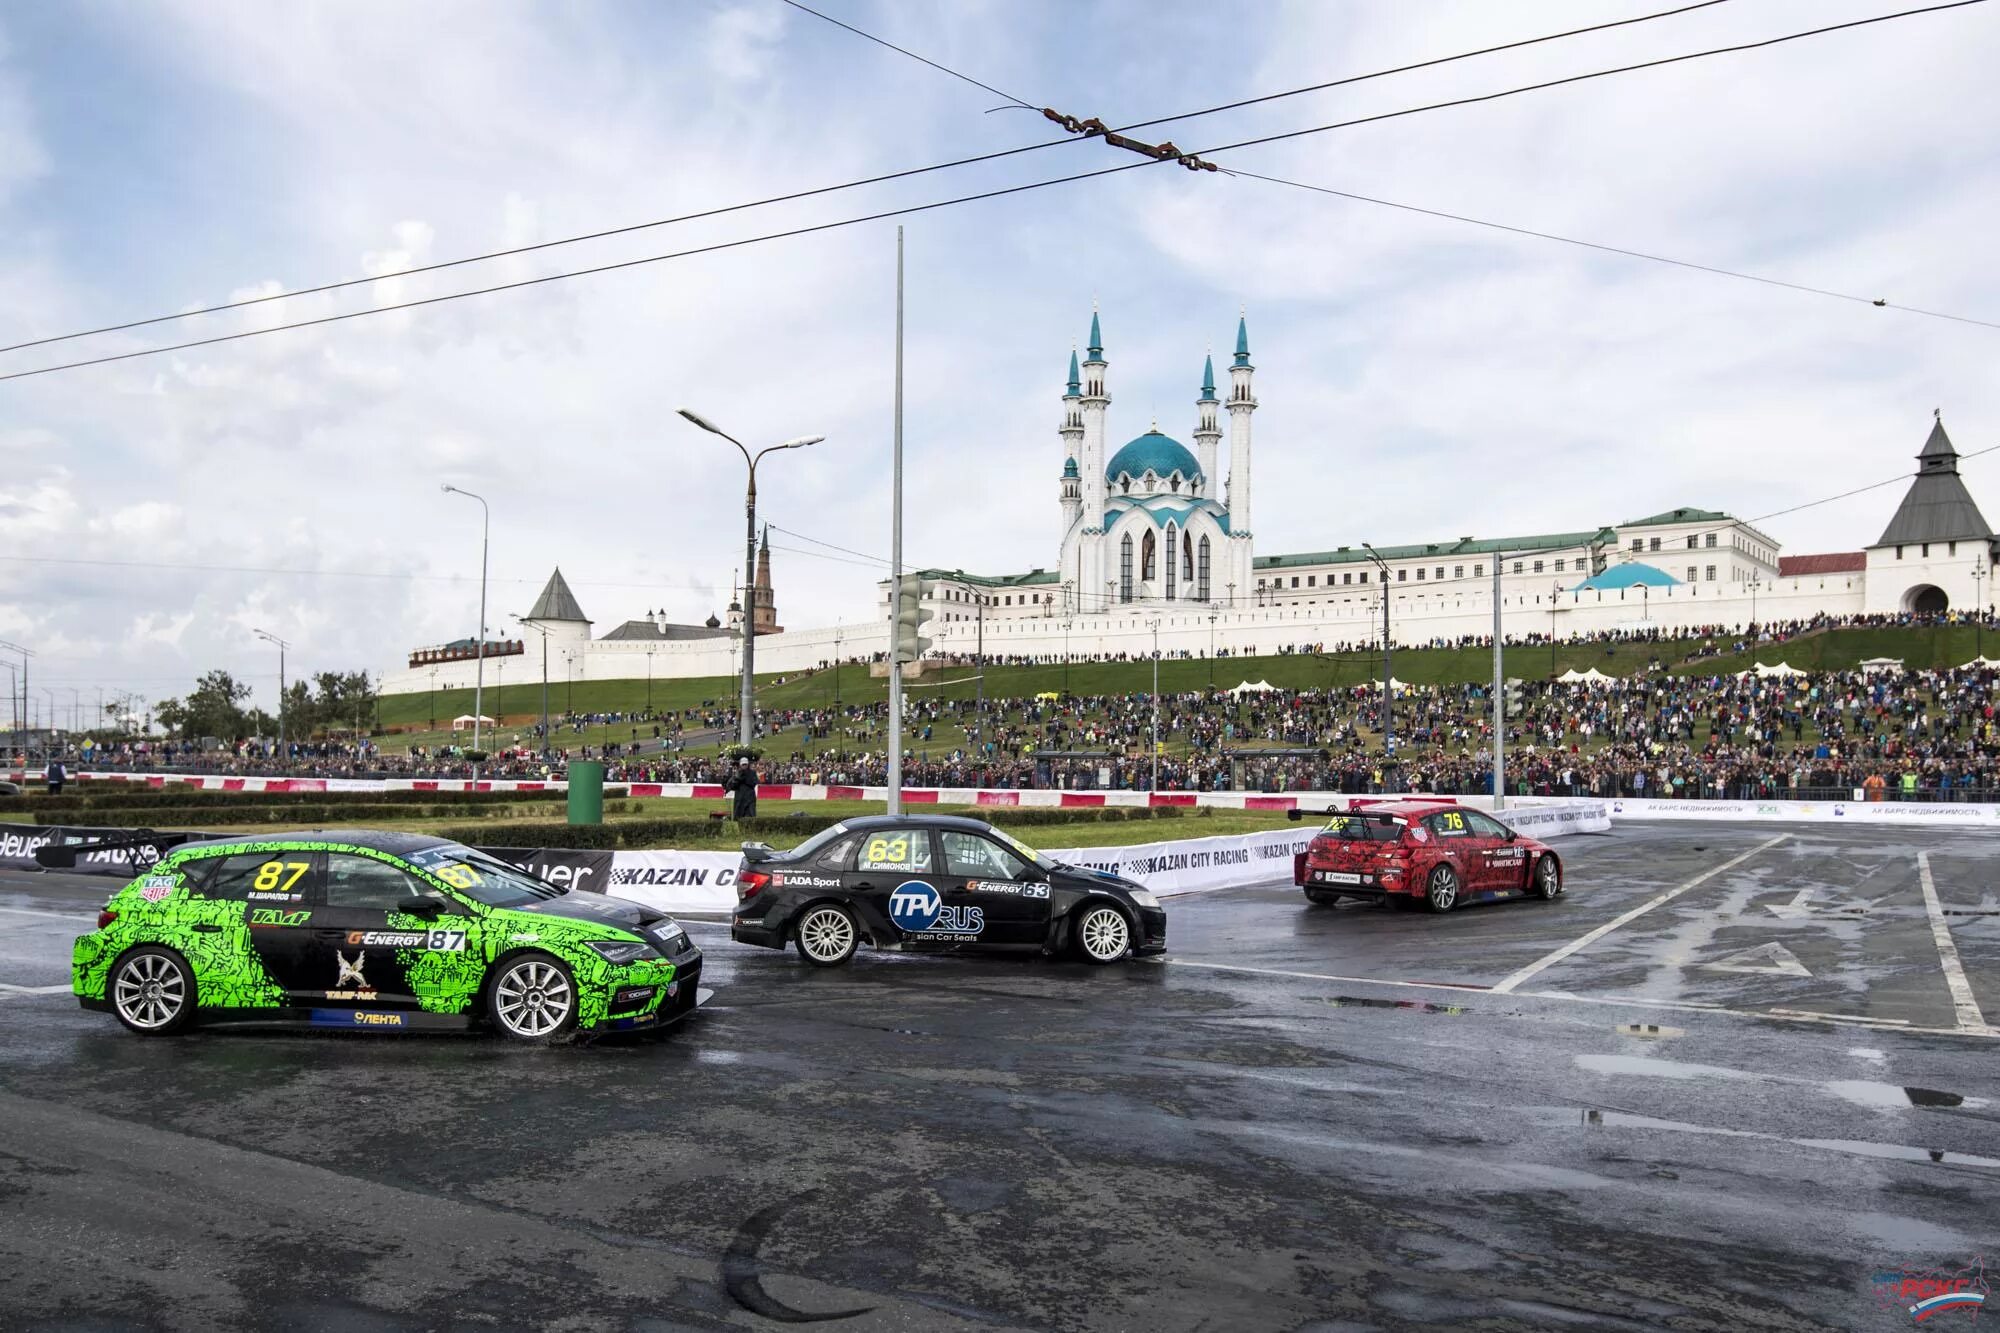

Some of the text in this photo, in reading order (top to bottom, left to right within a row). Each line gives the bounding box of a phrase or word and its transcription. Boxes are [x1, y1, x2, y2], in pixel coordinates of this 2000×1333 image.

[1443, 812, 1464, 830] 76
[868, 839, 908, 862] 63
[1265, 843, 1290, 859] KAZAN
[1150, 848, 1249, 874] KAZAN CITY RACING
[148, 878, 173, 888] TAG
[254, 861, 310, 891] 87
[435, 863, 484, 889] 87
[622, 867, 709, 886] KAZAN
[783, 876, 813, 886] LADA
[813, 877, 841, 887] Sport
[1024, 883, 1048, 897] 63
[890, 893, 985, 931] TPV RUS
[429, 930, 465, 950] 87
[936, 933, 953, 941] Car
[954, 934, 978, 942] Seats
[363, 1014, 402, 1025] ЛЕНТА
